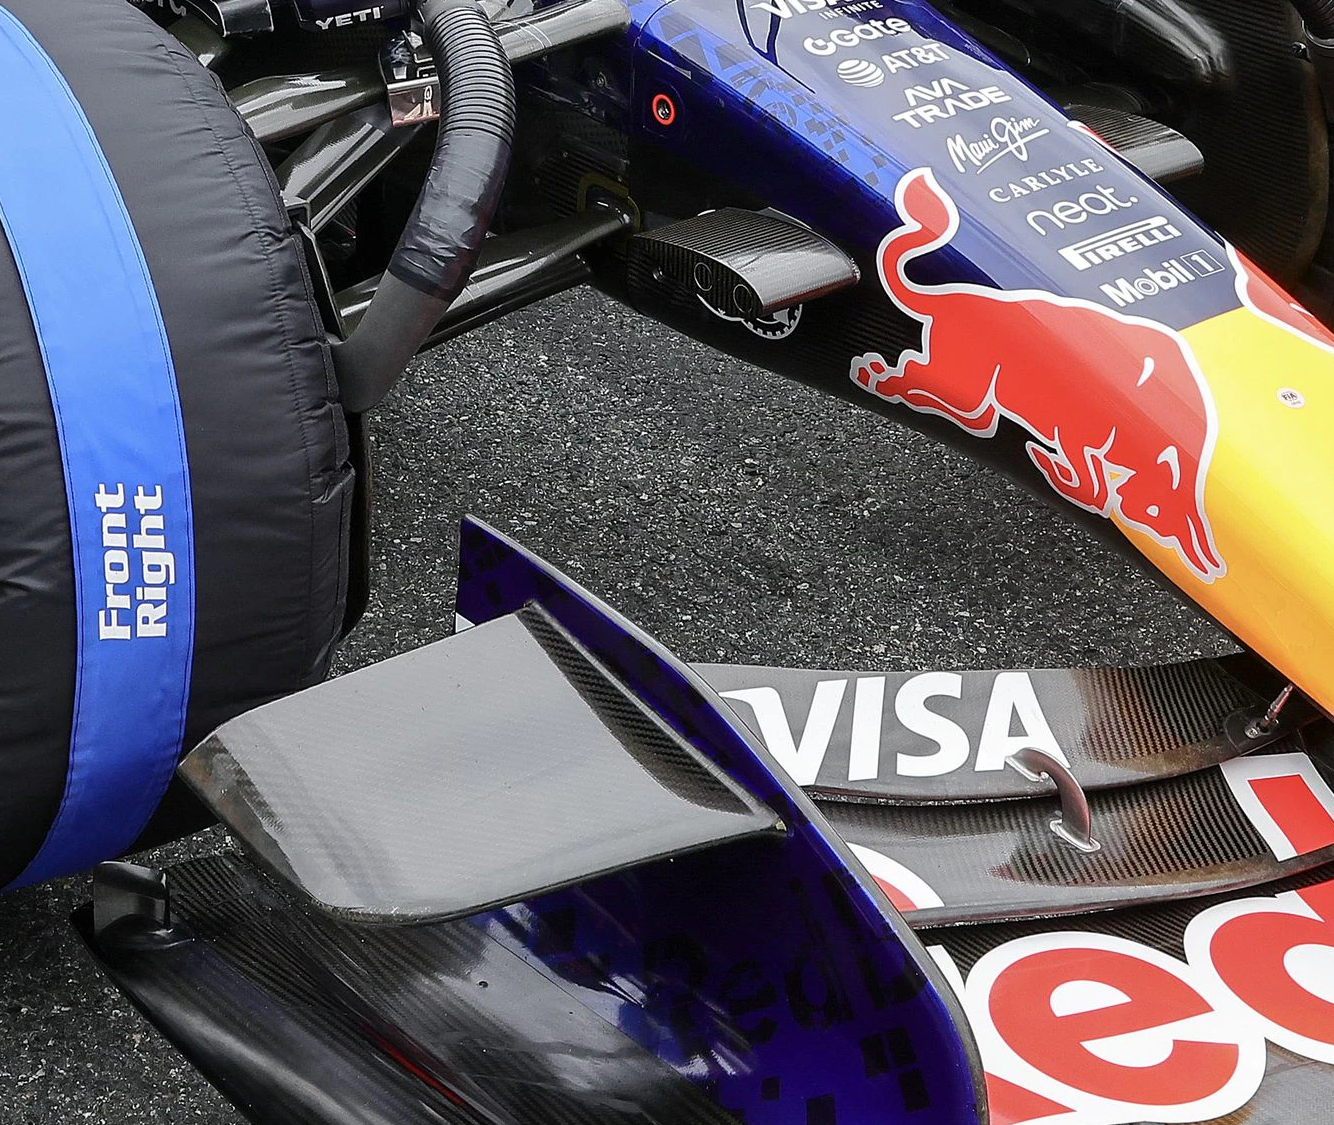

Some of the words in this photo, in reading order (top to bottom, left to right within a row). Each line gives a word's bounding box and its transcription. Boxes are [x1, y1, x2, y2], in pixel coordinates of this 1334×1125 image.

[315, 5, 385, 31] YETI
[818, 0, 884, 20] INFINITE
[881, 41, 951, 75] AT&T
[892, 86, 1013, 129] TRADE
[903, 77, 971, 107] AVA
[945, 132, 995, 175] Maui
[988, 157, 1105, 203] CARLYLE
[1026, 183, 1140, 237] neat.
[1057, 215, 1183, 272] PIRELLI
[1098, 261, 1190, 308] Mobil
[93, 480, 133, 642] Front
[134, 483, 177, 640] Right
[721, 670, 1071, 786] VISA
